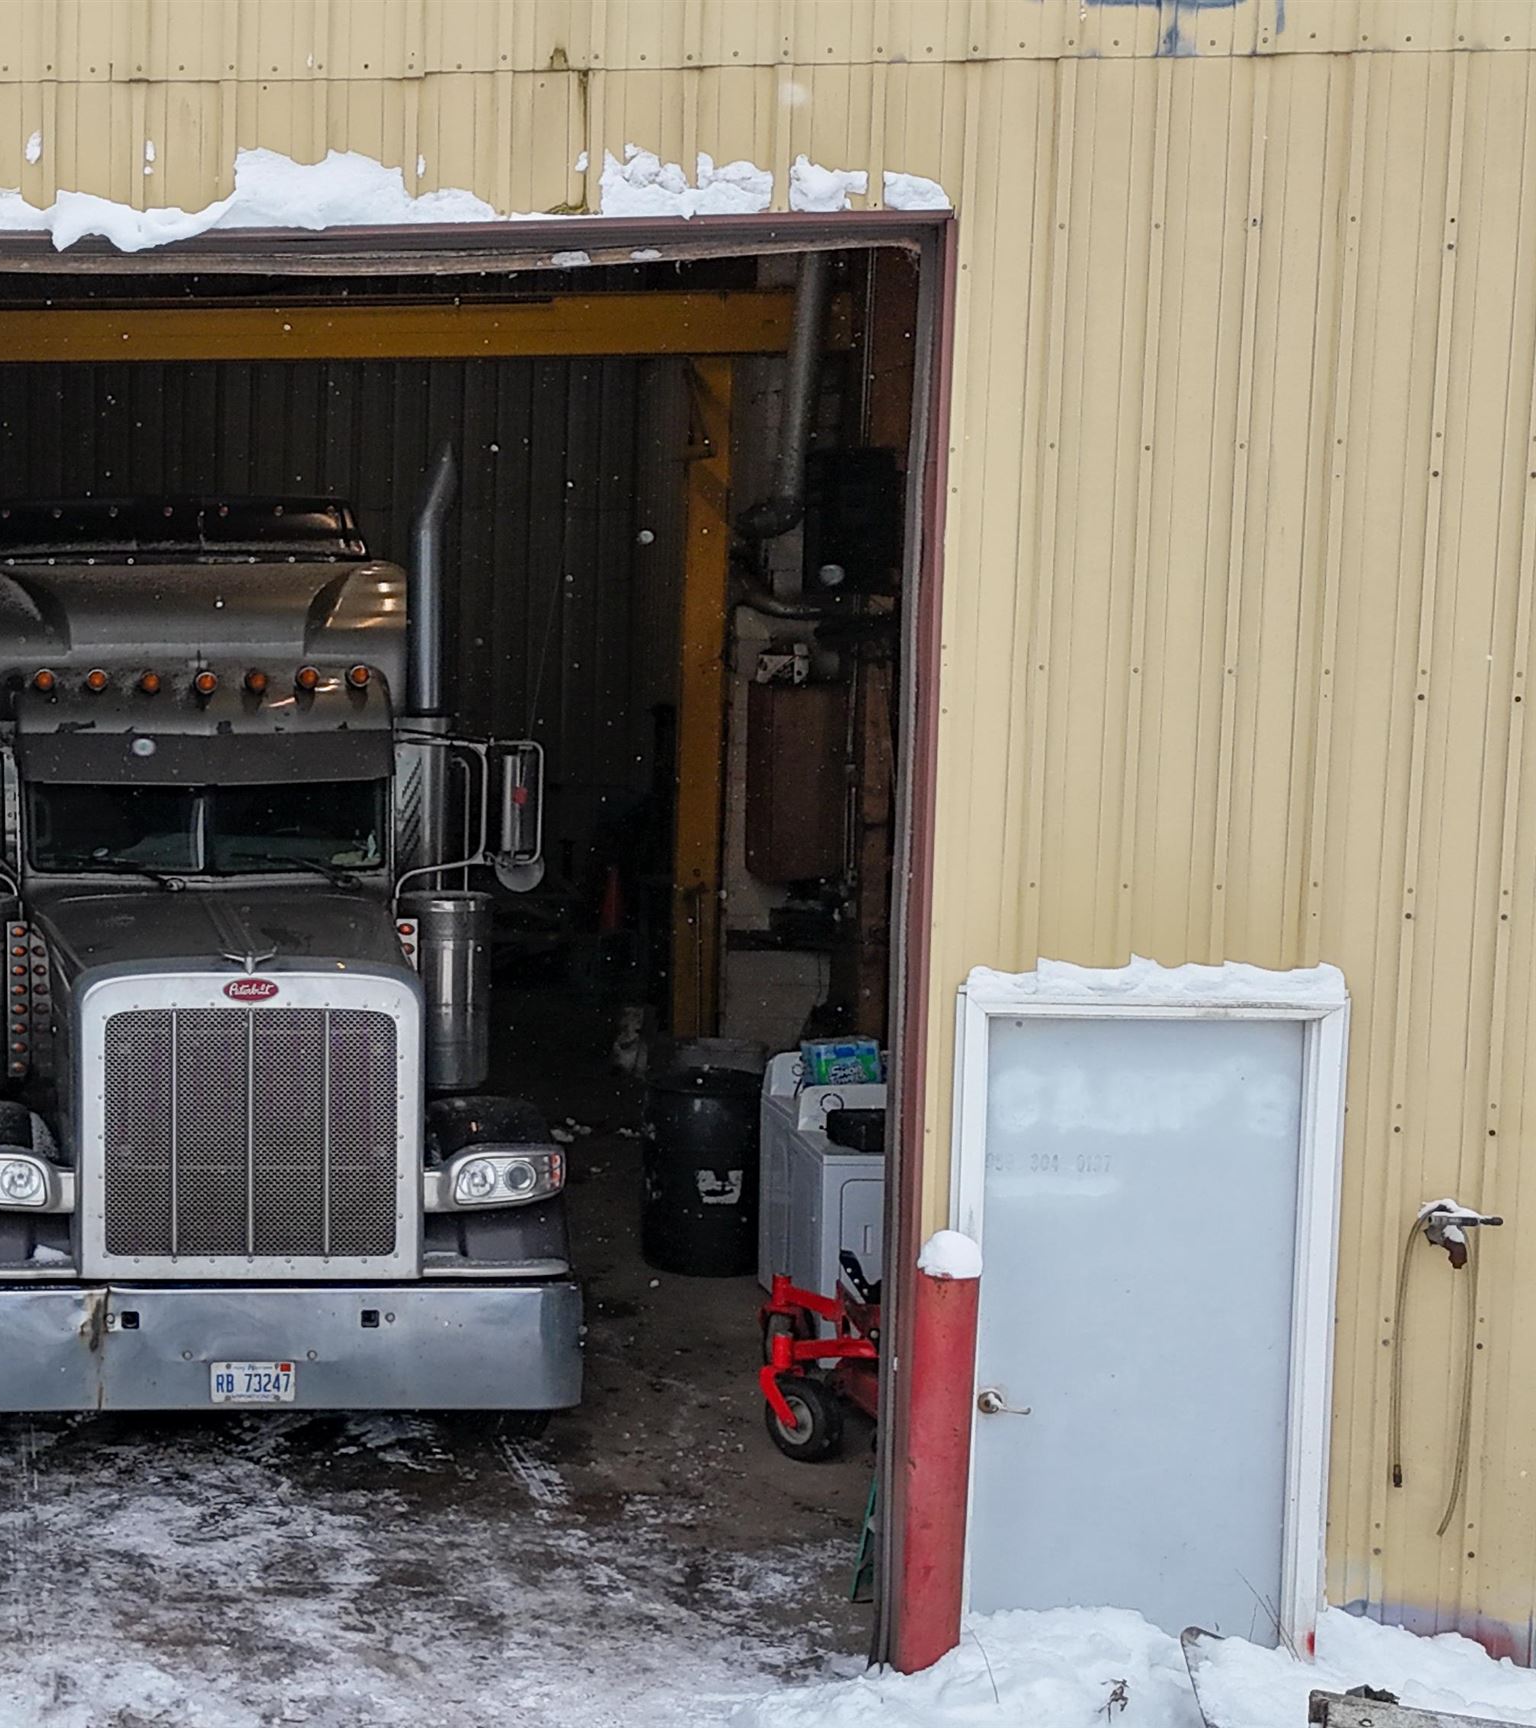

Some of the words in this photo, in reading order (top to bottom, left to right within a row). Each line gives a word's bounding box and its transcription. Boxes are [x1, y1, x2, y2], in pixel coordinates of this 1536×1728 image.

[229, 982, 275, 997] Peterbilt
[216, 1374, 234, 1393] RB
[244, 1373, 291, 1393] 73247
